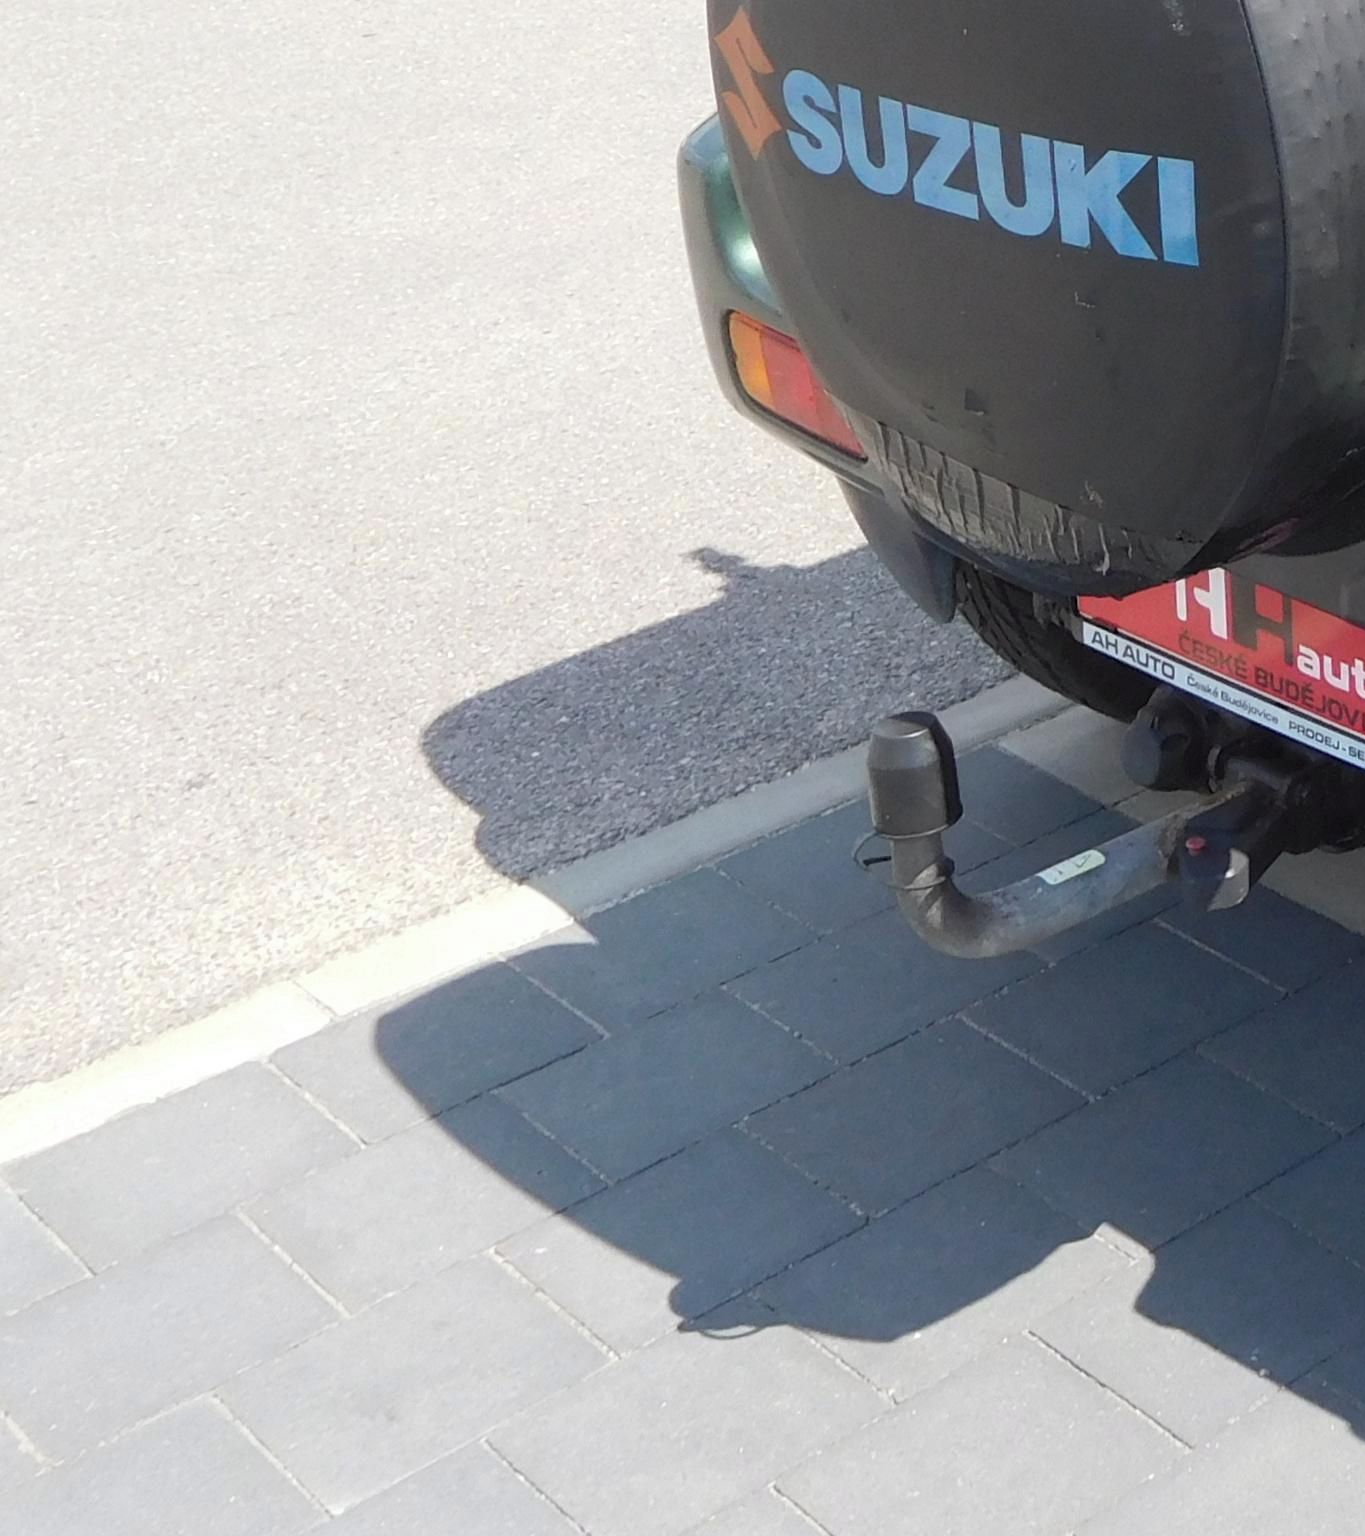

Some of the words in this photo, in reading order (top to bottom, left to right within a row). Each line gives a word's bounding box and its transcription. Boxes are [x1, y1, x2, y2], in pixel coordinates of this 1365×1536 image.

[782, 69, 1199, 267] SUZUKI
[1091, 631, 1119, 655] AH
[1122, 645, 1176, 680] AUTO
[1186, 675, 1219, 698] České
[1221, 691, 1279, 725] Budějovice
[1288, 720, 1340, 751] PRODEJ
[1178, 629, 1248, 680] ČESKÉ
